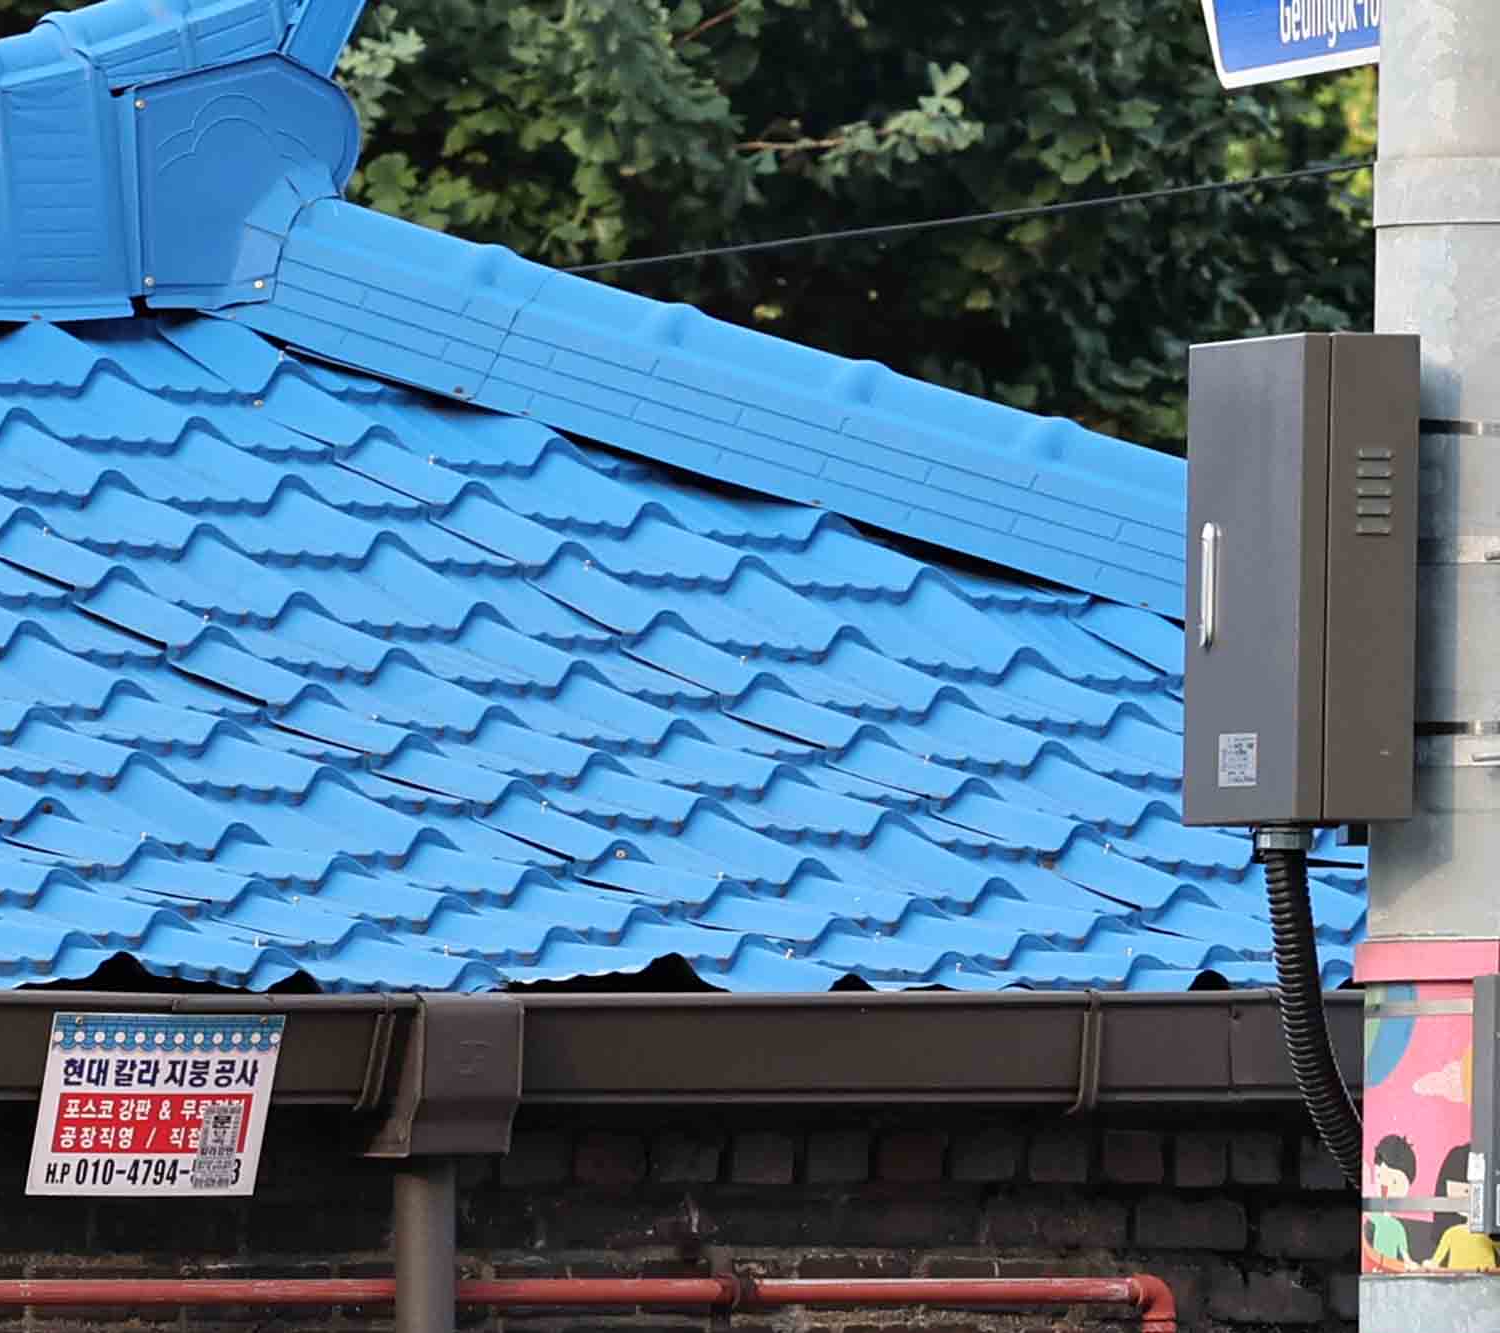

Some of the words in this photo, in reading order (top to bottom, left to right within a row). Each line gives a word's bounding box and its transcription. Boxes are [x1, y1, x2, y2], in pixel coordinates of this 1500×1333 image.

[63, 1058, 109, 1087] 현대
[114, 1058, 160, 1087] 칼라
[164, 1059, 210, 1087] 지붕
[214, 1058, 258, 1088] 공사
[62, 1098, 114, 1120] 포스코
[119, 1098, 152, 1121] 강판
[159, 1100, 171, 1120] &
[60, 1126, 134, 1150] 공장직영
[45, 1162, 70, 1185] H.P
[75, 1158, 241, 1186] 010-4794-3
